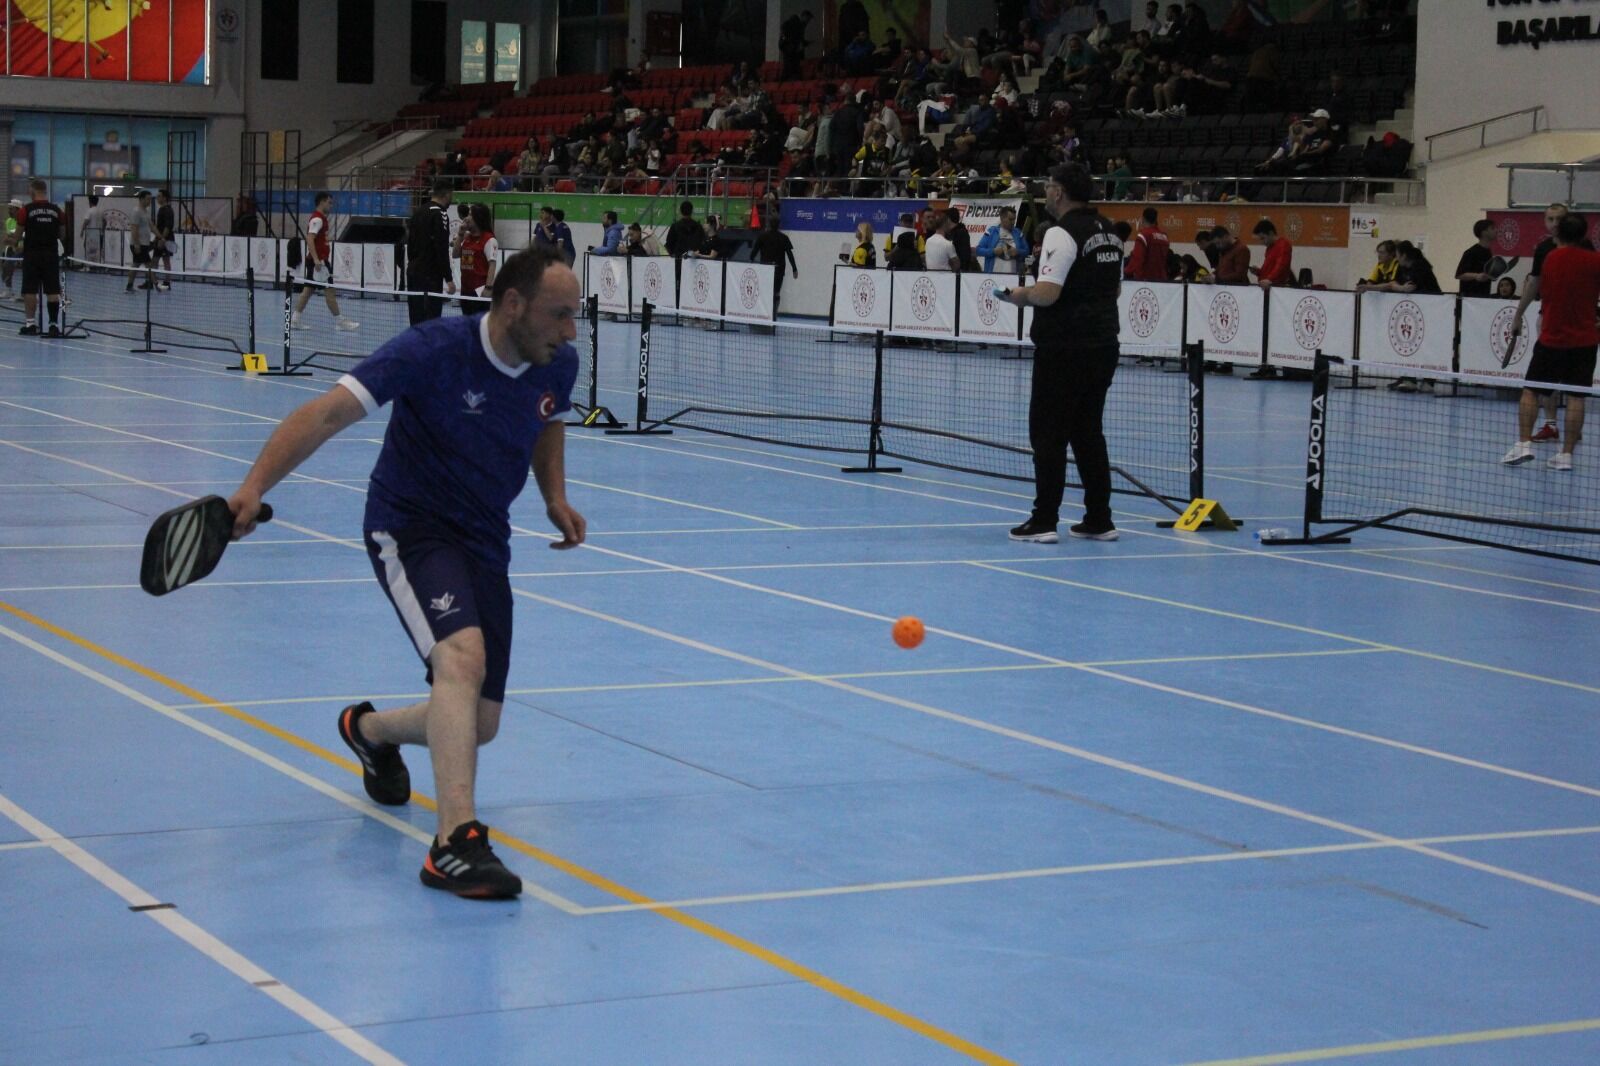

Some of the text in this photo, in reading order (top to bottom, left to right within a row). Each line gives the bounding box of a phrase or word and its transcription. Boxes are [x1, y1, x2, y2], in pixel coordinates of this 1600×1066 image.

[1497, 15, 1600, 50] BAŞARIL
[1097, 252, 1119, 263] HASAN
[251, 356, 259, 369] 7
[640, 331, 649, 384] JOOLA
[1191, 402, 1199, 473] JOOLA
[1309, 394, 1324, 471] JOOLA
[1184, 503, 1205, 526] 5
